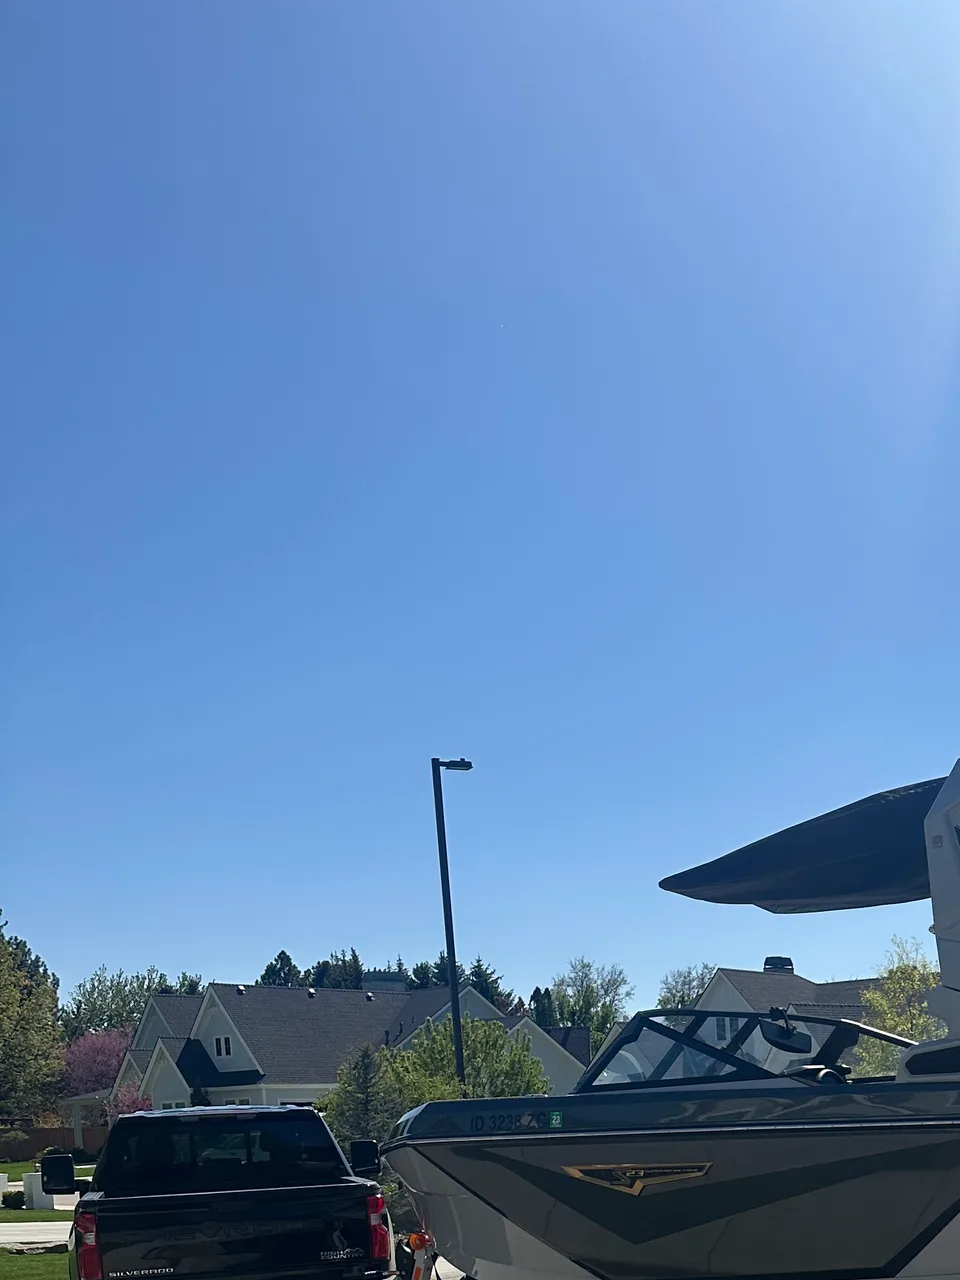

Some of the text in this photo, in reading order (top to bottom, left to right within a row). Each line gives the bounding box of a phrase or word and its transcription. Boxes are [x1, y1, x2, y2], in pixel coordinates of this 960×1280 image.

[470, 1115, 485, 1132] ID
[488, 1114, 522, 1131] 3238
[551, 1115, 561, 1124] 23
[108, 1267, 174, 1278] SILVERADO
